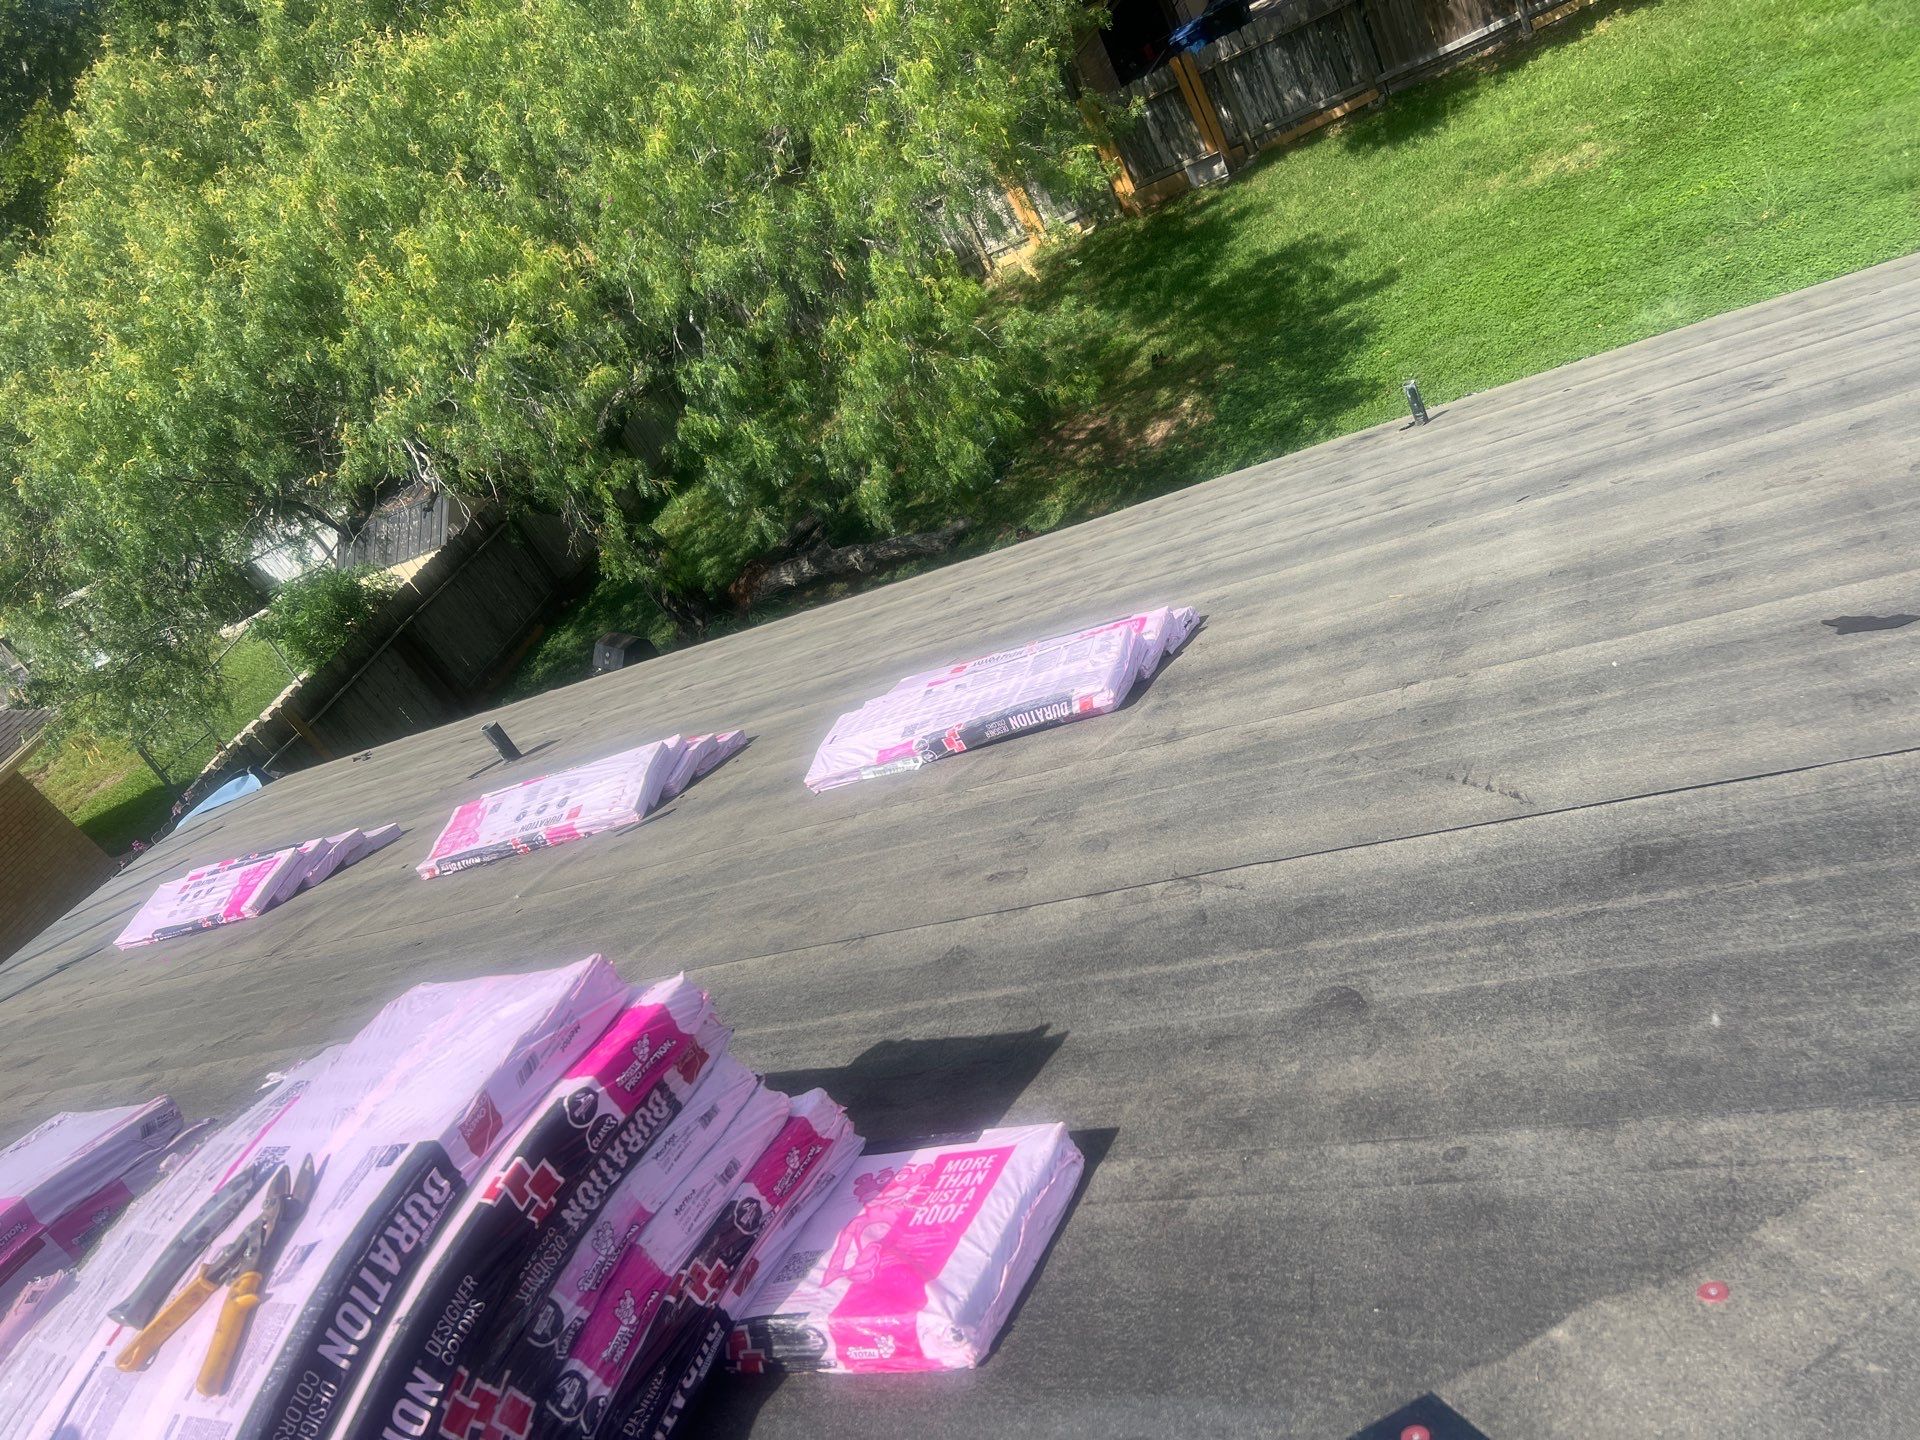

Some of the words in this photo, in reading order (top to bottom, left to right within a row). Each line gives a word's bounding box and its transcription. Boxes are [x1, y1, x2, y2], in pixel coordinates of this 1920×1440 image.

[1008, 701, 1071, 730] DURATION
[519, 813, 564, 833] DURATION
[561, 1088, 671, 1231] DURATION
[942, 1154, 998, 1174] MORE
[935, 1170, 989, 1190] THAN
[922, 1189, 963, 1206] JUST
[963, 1187, 976, 1202] A
[909, 1203, 969, 1226] ROOF
[317, 1166, 452, 1371] DURATION
[424, 1273, 479, 1358] DESIGNER
[441, 1297, 486, 1367] COLORS
